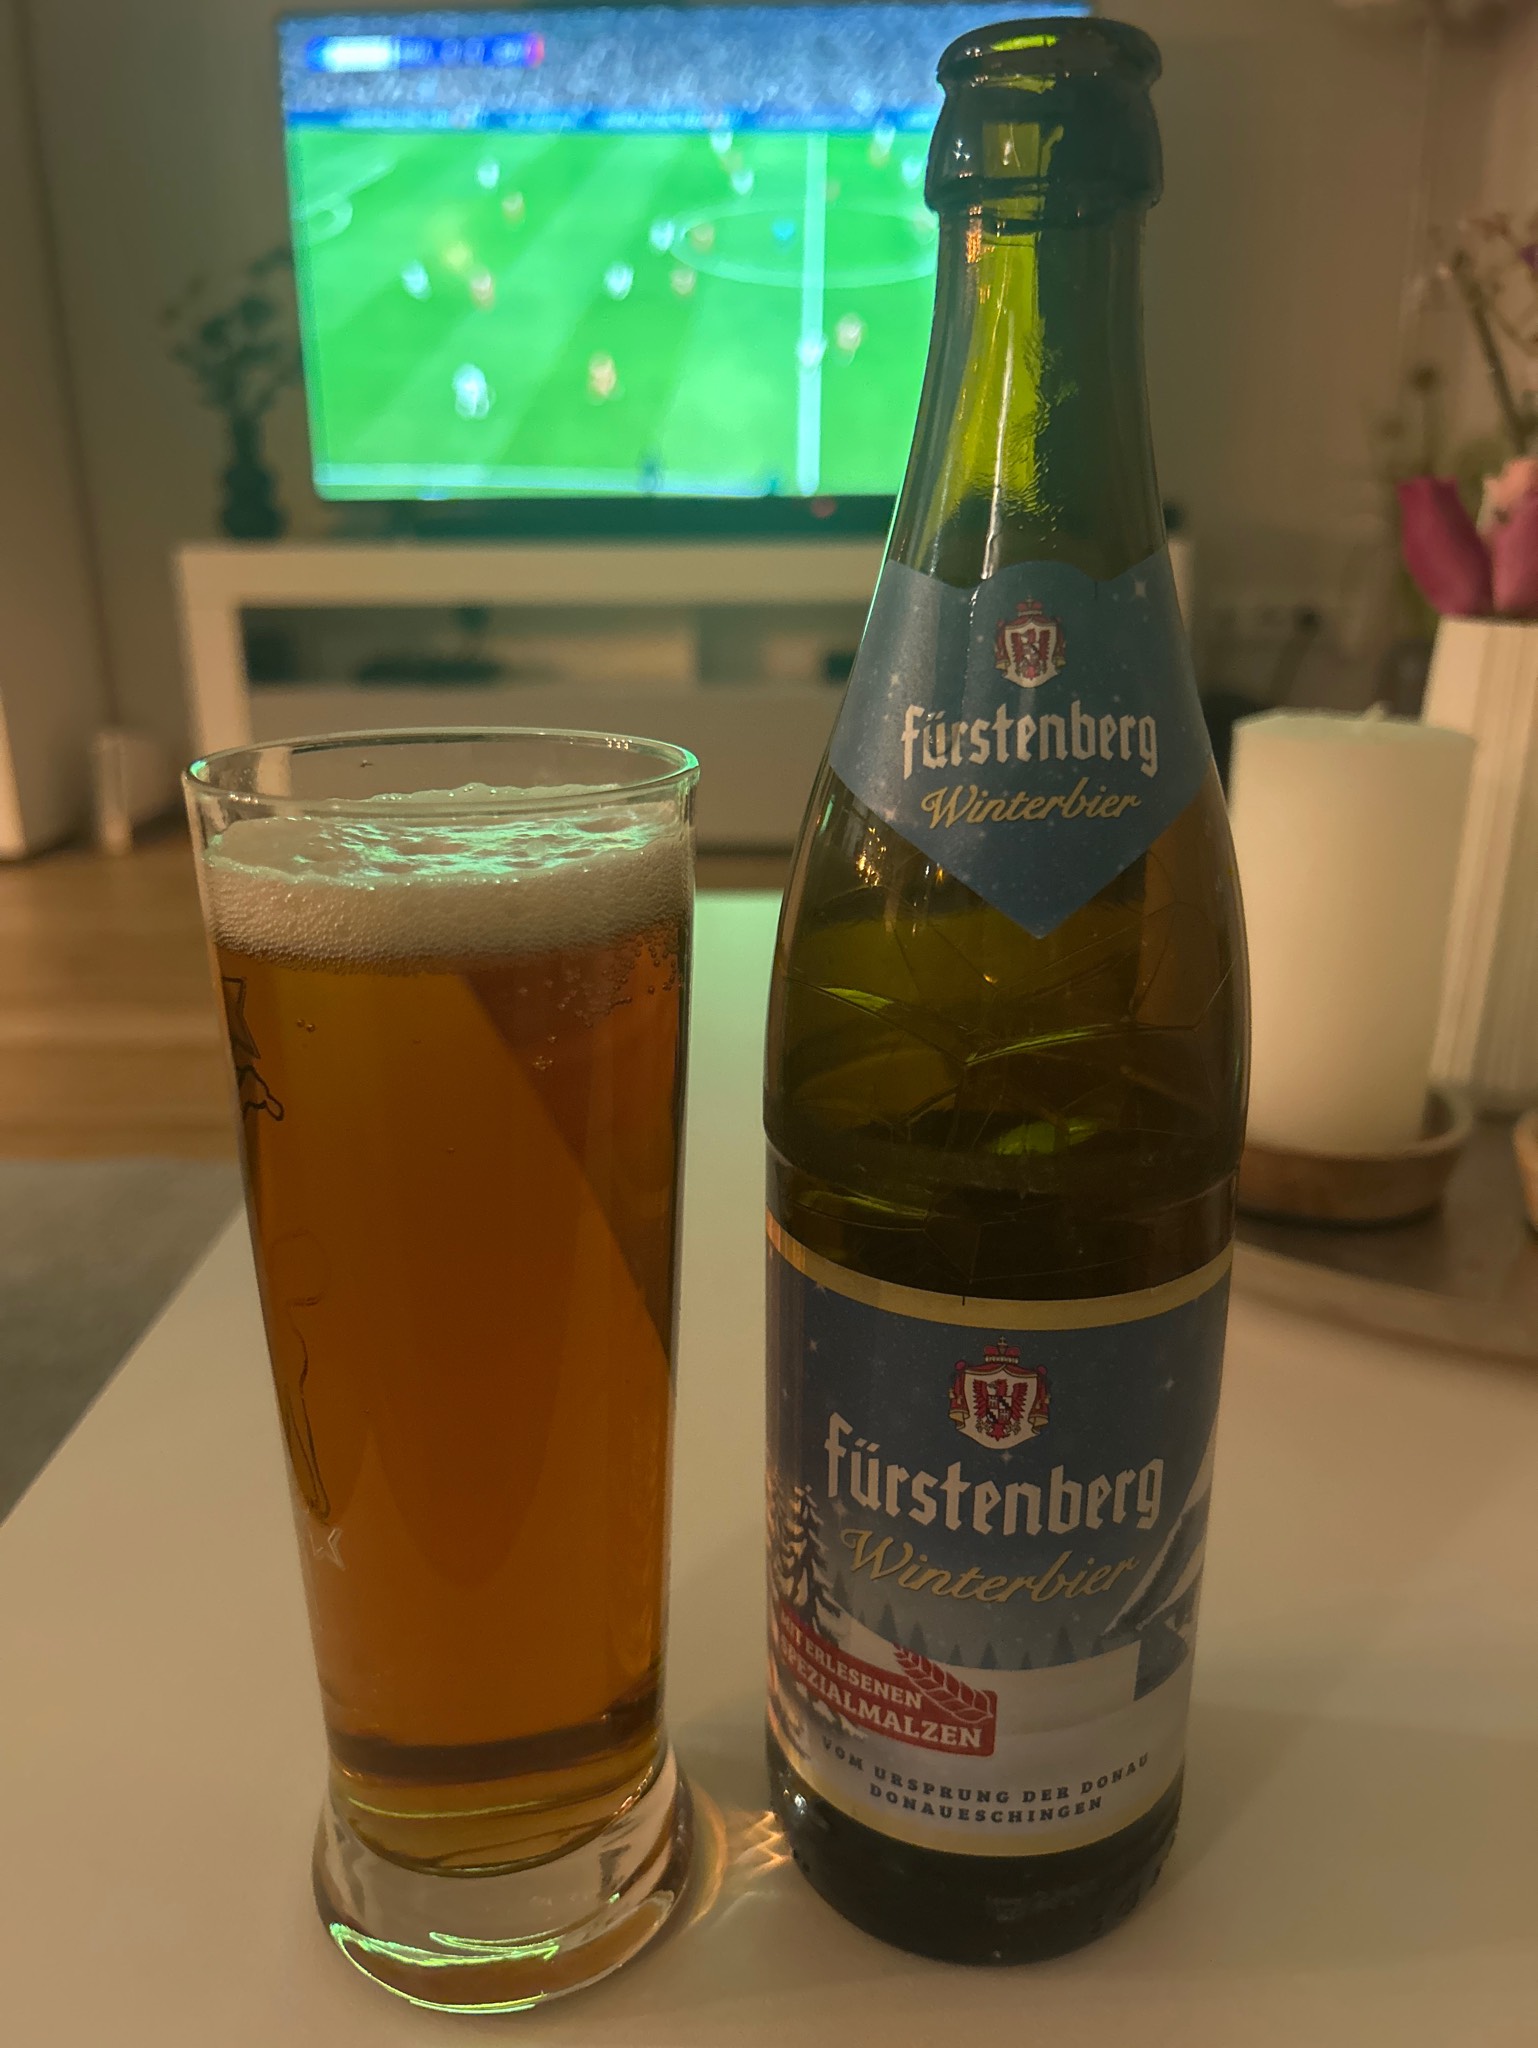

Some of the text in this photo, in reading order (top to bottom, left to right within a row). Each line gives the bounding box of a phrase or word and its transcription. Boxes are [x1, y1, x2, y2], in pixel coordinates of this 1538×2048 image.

[901, 700, 1158, 780] fürstenberg
[920, 777, 1141, 830] Winterbier
[824, 1411, 1164, 1537] fürstenberg
[841, 1528, 1140, 1604] Winterbier
[780, 1633, 982, 1749] SPEZIALMALZEN
[805, 1636, 923, 1710] ERLESENEN
[822, 1735, 1149, 1804] VOM URSPRUNG DER DONAU
[869, 1783, 1103, 1824] DONAUESCHINGEN
